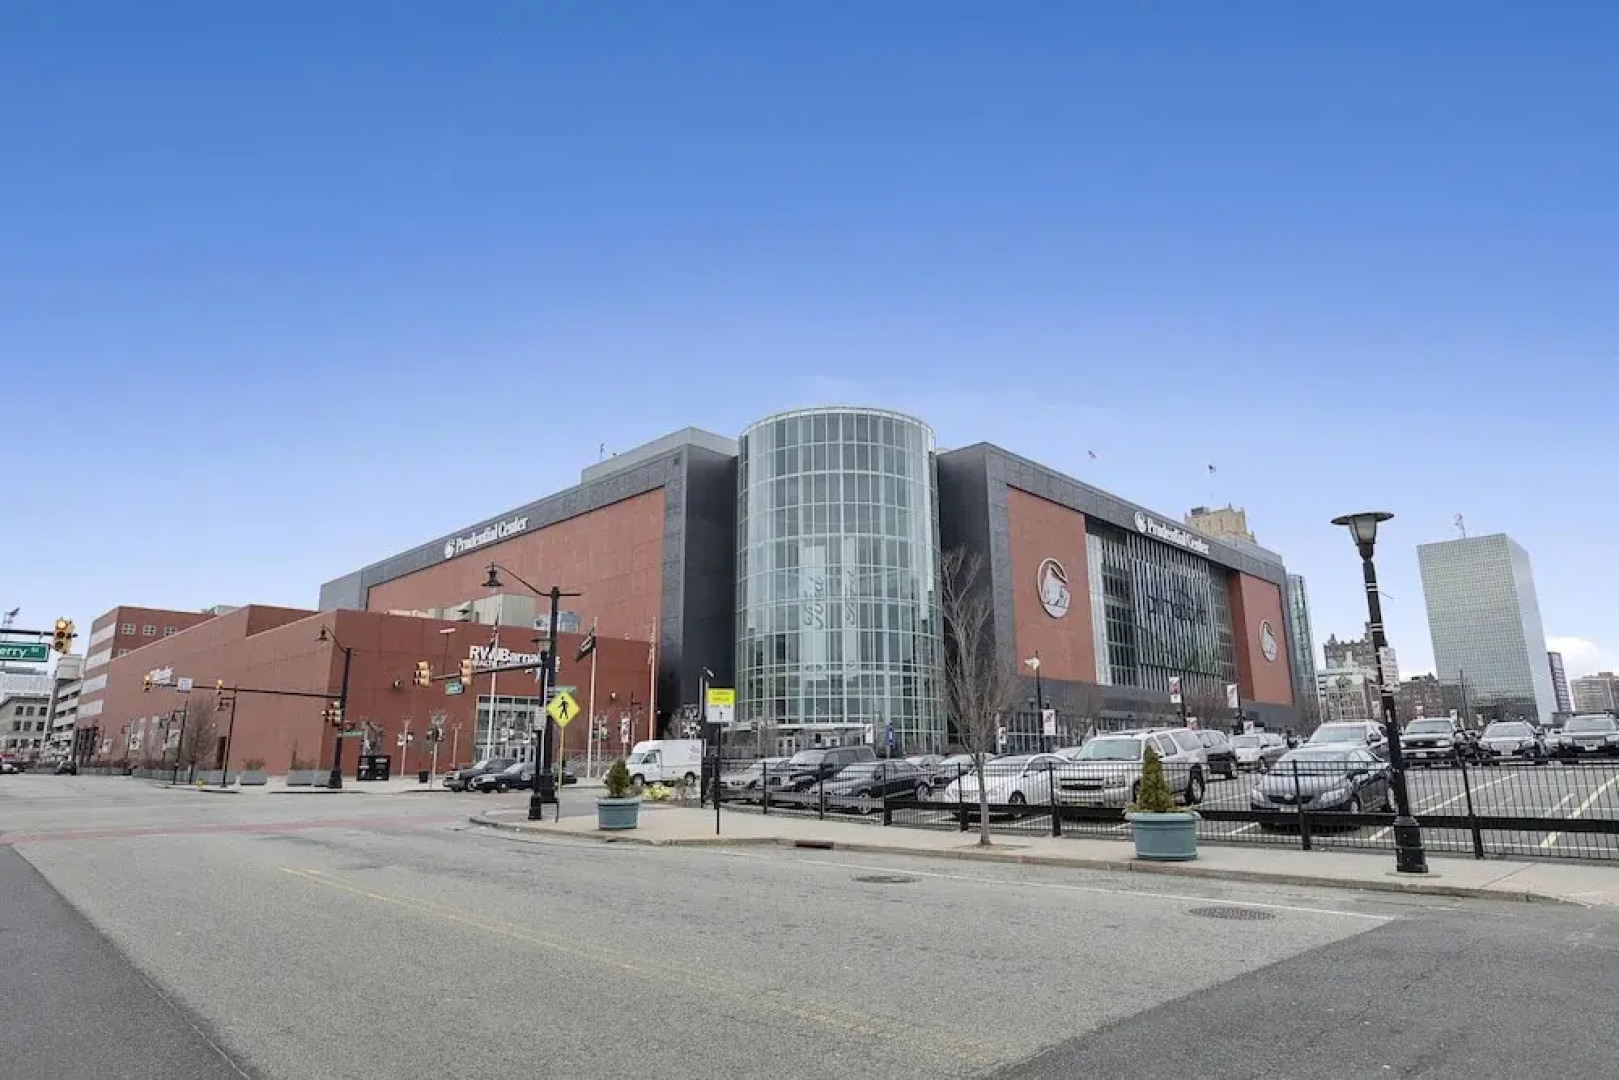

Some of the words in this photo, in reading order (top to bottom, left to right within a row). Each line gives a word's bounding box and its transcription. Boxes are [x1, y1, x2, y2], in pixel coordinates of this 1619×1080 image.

[456, 523, 498, 553] Prudential
[499, 516, 528, 536] Center
[1147, 517, 1186, 547] Prudential
[1187, 533, 1209, 555] Center
